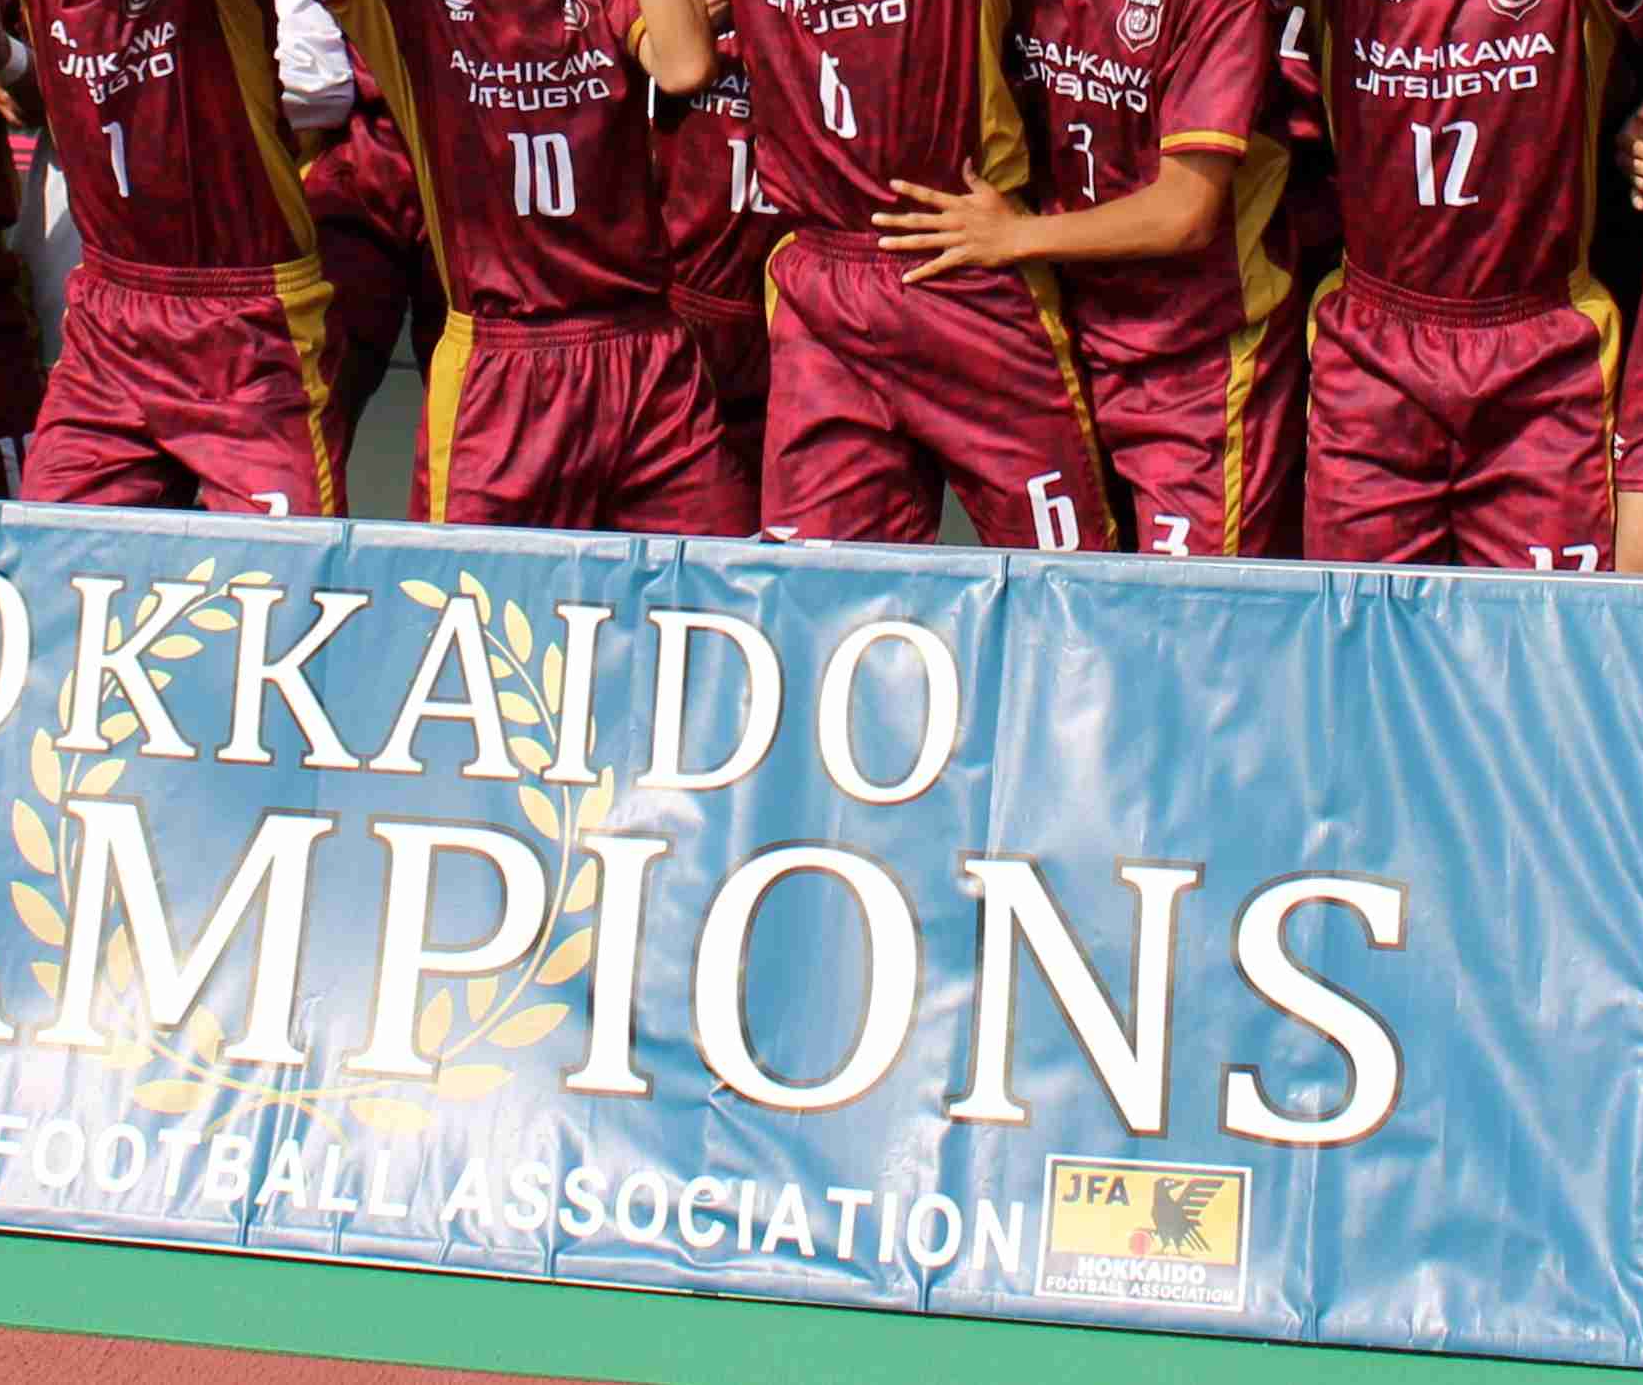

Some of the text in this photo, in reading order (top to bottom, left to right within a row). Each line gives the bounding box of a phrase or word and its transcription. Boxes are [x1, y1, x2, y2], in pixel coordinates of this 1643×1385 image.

[1355, 63, 1537, 100] JITSUGYO
[101, 120, 131, 199] 1
[508, 131, 578, 218] 10
[1409, 119, 1481, 208] 12
[1026, 470, 1082, 554] 6
[436, 1150, 1028, 1275] ASSOCIATION
[1061, 1173, 1131, 1207] JFA
[1045, 1275, 1234, 1305] FOOTBALL ASSOCIATION
[1076, 1256, 1208, 1286] HOKKAIDO
